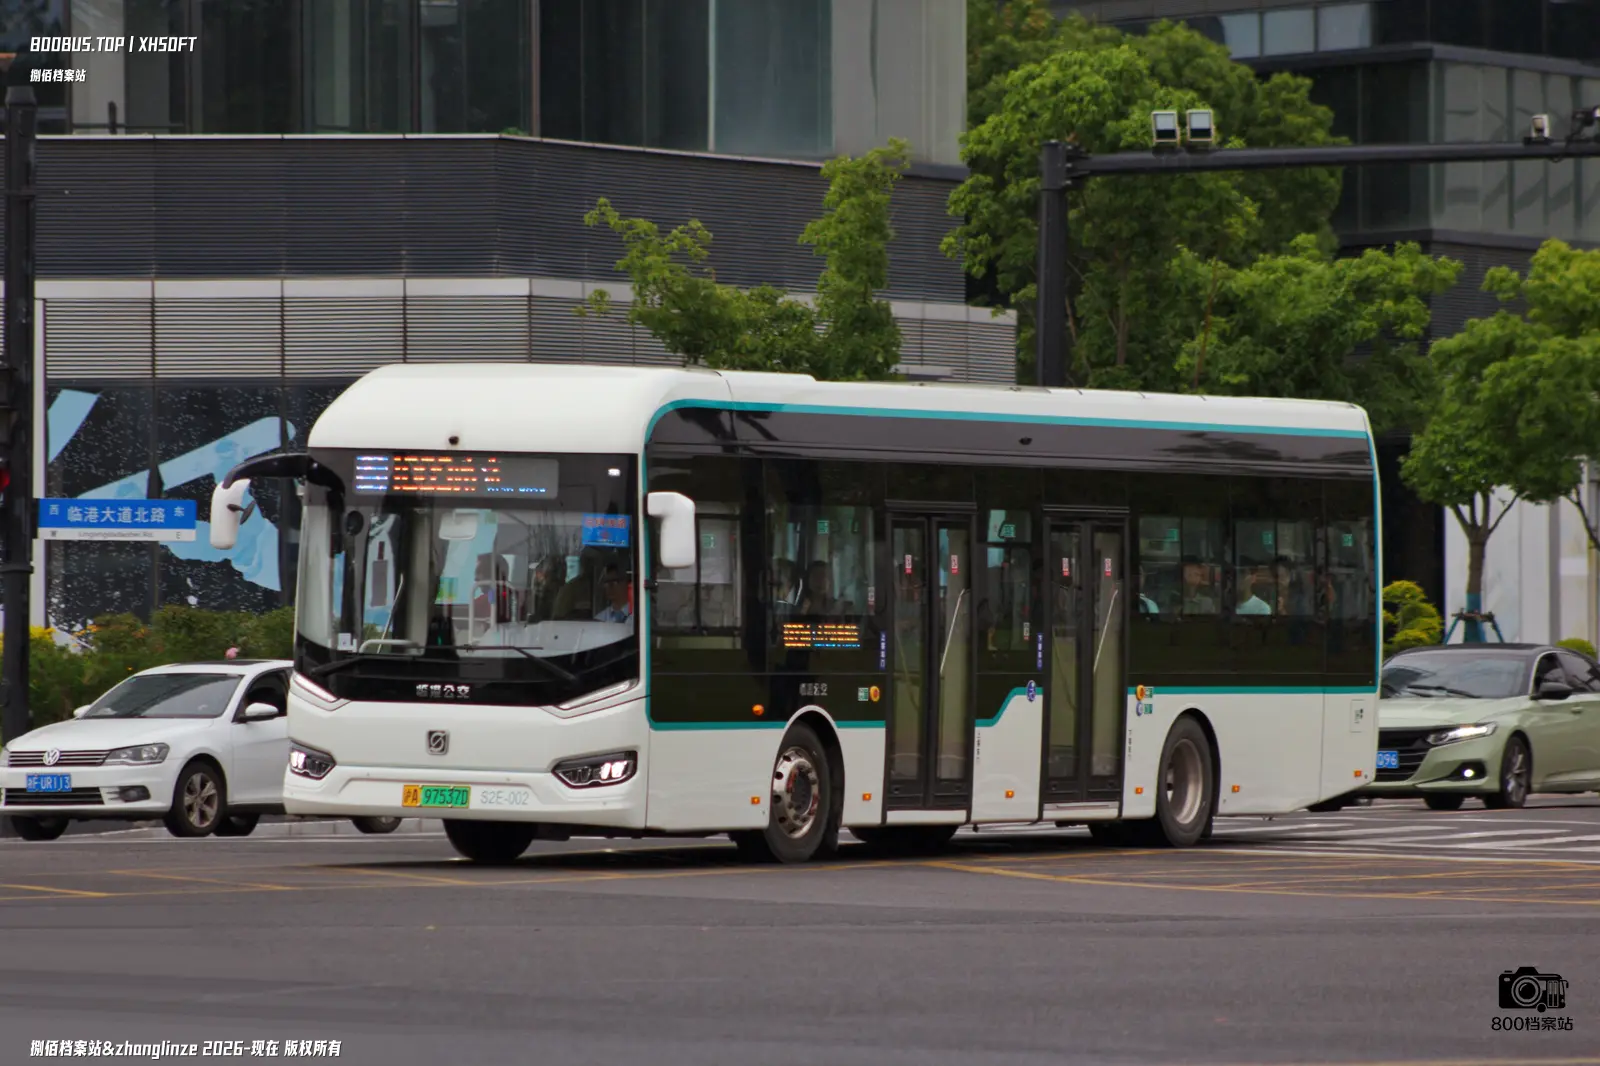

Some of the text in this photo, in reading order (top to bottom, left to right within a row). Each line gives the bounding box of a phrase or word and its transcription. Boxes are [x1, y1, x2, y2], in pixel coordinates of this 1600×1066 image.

[49, 504, 185, 523] 西 临港大道北路 东
[480, 790, 530, 806] S2E-002
